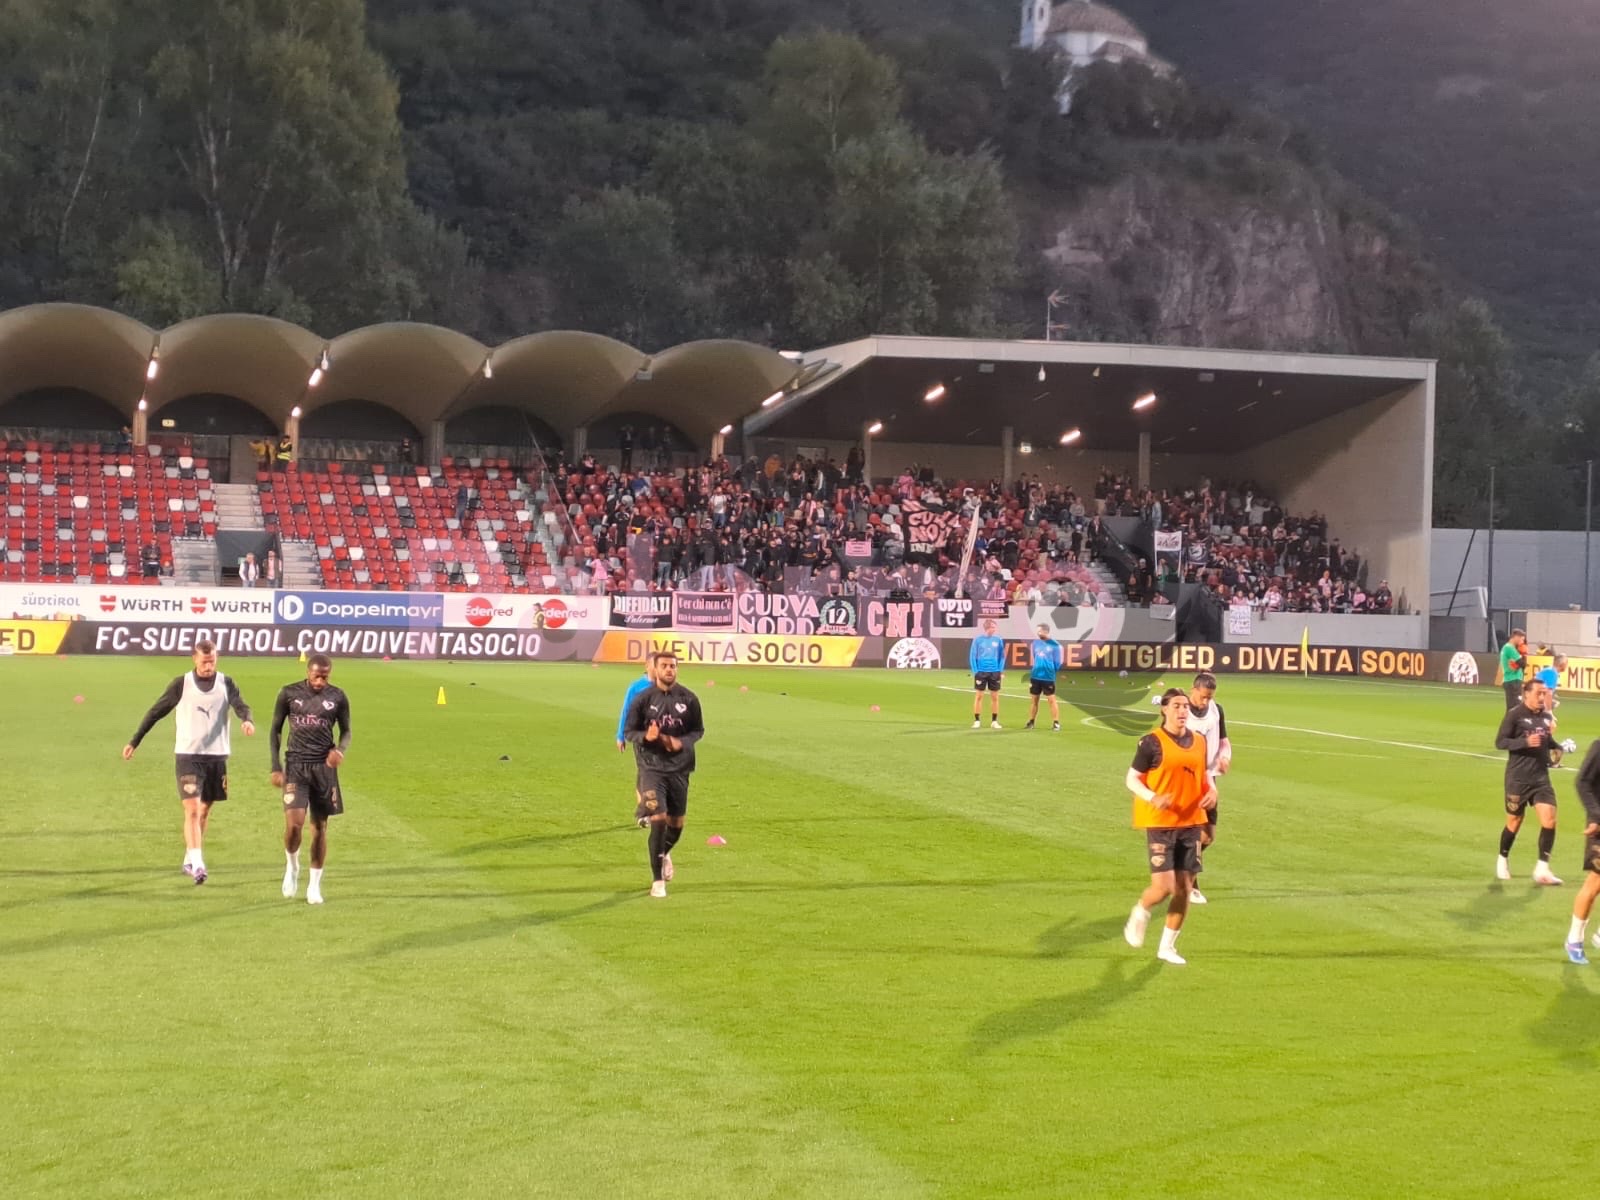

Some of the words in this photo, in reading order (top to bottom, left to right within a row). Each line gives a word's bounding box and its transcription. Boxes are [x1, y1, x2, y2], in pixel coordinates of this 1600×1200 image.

[121, 597, 183, 612] WÜRTH
[212, 600, 272, 614] WÜRTH
[312, 602, 441, 619] Doppelmayr
[465, 604, 514, 617] Edenred
[614, 596, 670, 613] DIFFIDATI
[739, 593, 820, 617] CURVA
[828, 607, 847, 625] 12
[867, 601, 924, 637] CNI
[946, 613, 965, 626] CT
[627, 639, 738, 662] DIVENTA
[747, 642, 823, 663] SOCIO
[1091, 644, 1215, 671] MITGLIED
[1238, 646, 1354, 673] DIVENTA
[1361, 650, 1425, 676] SOCIO
